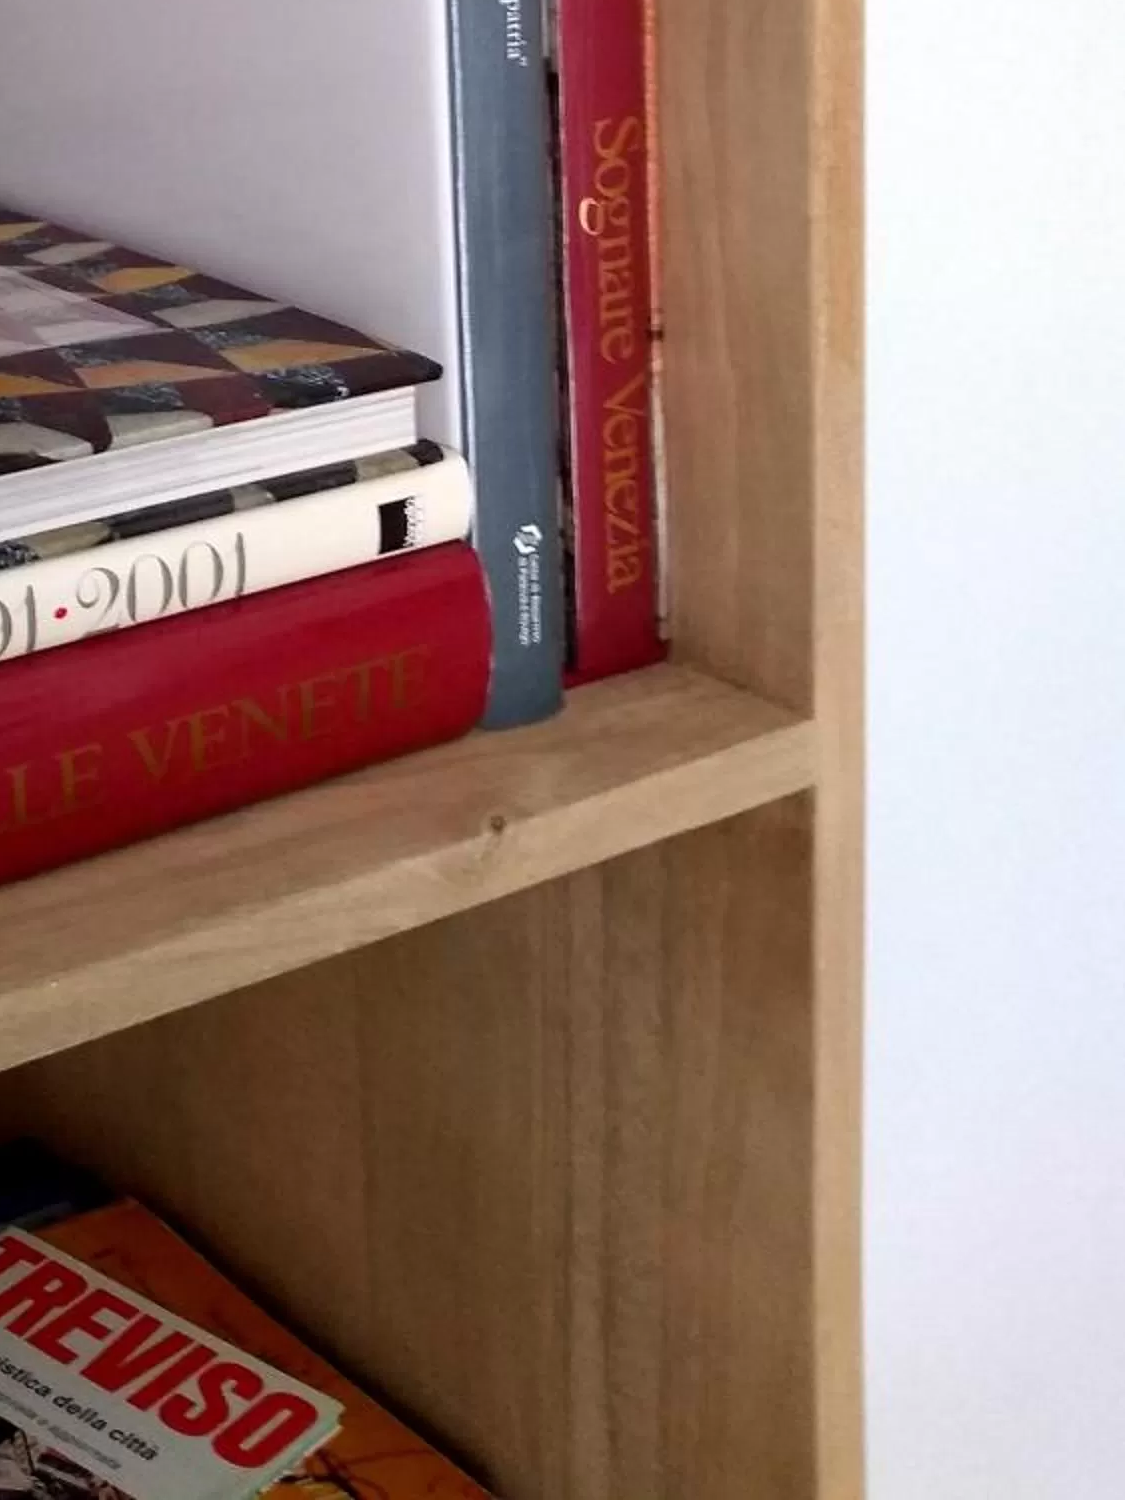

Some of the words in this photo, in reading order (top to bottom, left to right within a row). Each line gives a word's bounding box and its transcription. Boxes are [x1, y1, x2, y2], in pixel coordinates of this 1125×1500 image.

[579, 116, 641, 363] Sognare
[599, 367, 644, 593] Venezia
[128, 643, 432, 780] VENETE
[52, 1393, 108, 1432] della
[108, 1427, 159, 1461] città
